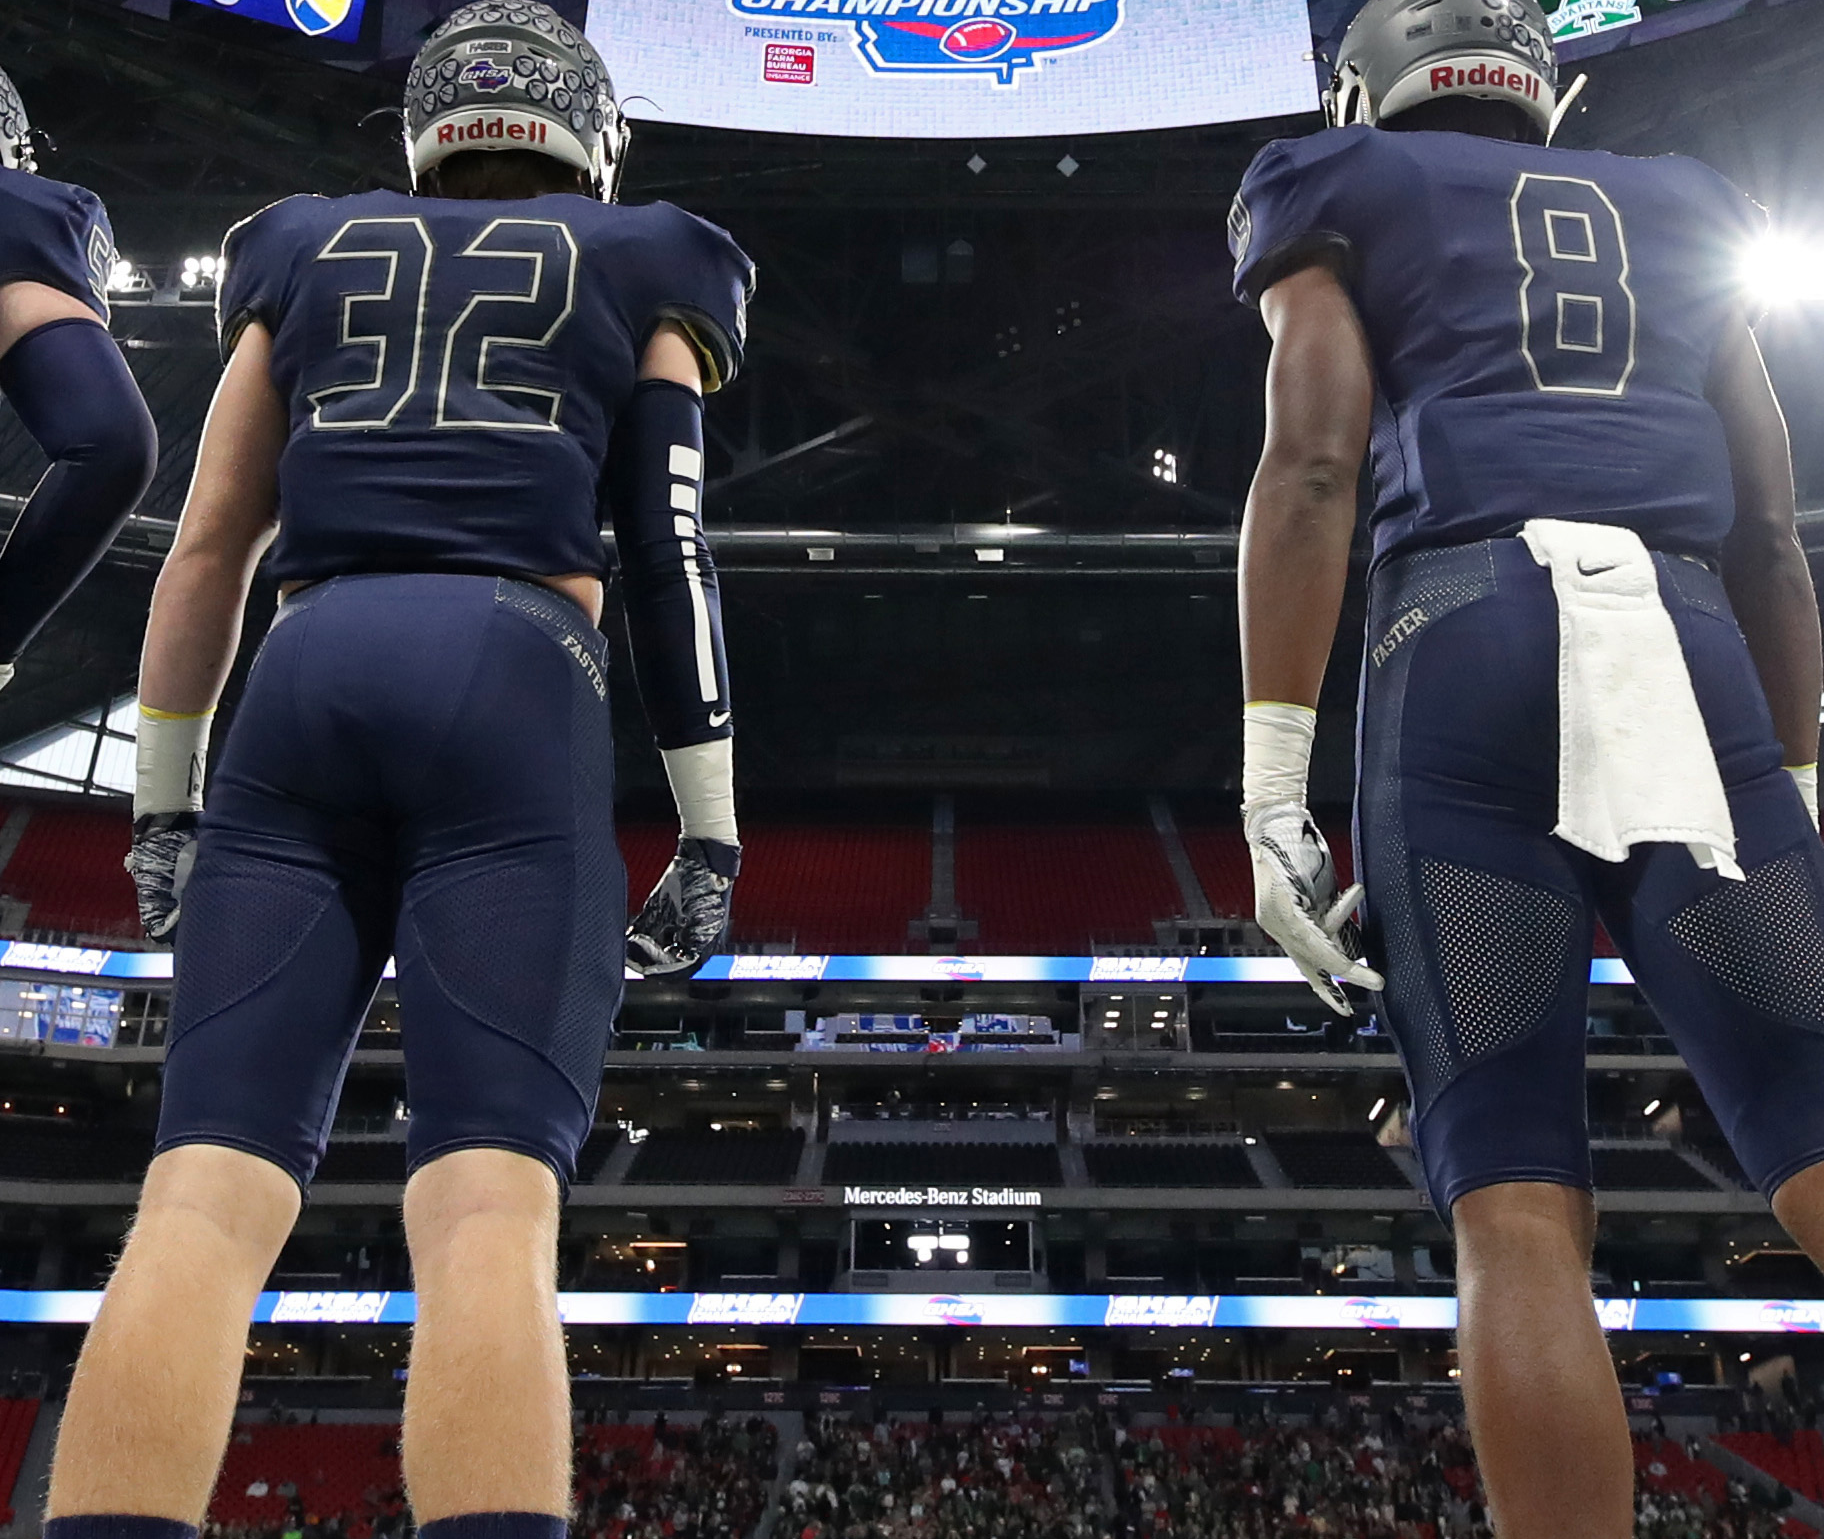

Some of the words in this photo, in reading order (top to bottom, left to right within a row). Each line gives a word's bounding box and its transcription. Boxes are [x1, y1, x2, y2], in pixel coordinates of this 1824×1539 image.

[1550, 0, 1626, 30] SPARTANS
[744, 26, 813, 41] PRESENTED
[817, 31, 838, 43] BY:
[767, 47, 813, 57] GEORGIA
[767, 55, 795, 63] FARM
[461, 68, 510, 81] GHSA
[766, 62, 807, 71] BUREAU
[765, 73, 811, 82] INSURANCE
[1429, 62, 1540, 102] Riddell
[436, 116, 547, 146] Riddell
[1508, 171, 1639, 397] 8
[306, 216, 580, 433] 32
[1371, 606, 1430, 669] FASTER
[560, 633, 609, 703] FASTER
[932, 963, 985, 974] GHSA
[844, 1186, 968, 1206] Mercedes-Benz
[971, 1186, 1042, 1206] Stadium
[697, 1294, 796, 1312] GHSA
[923, 1303, 986, 1316] GHSA
[1114, 1296, 1212, 1313] GHSA
[1340, 1305, 1401, 1319] GHSA
